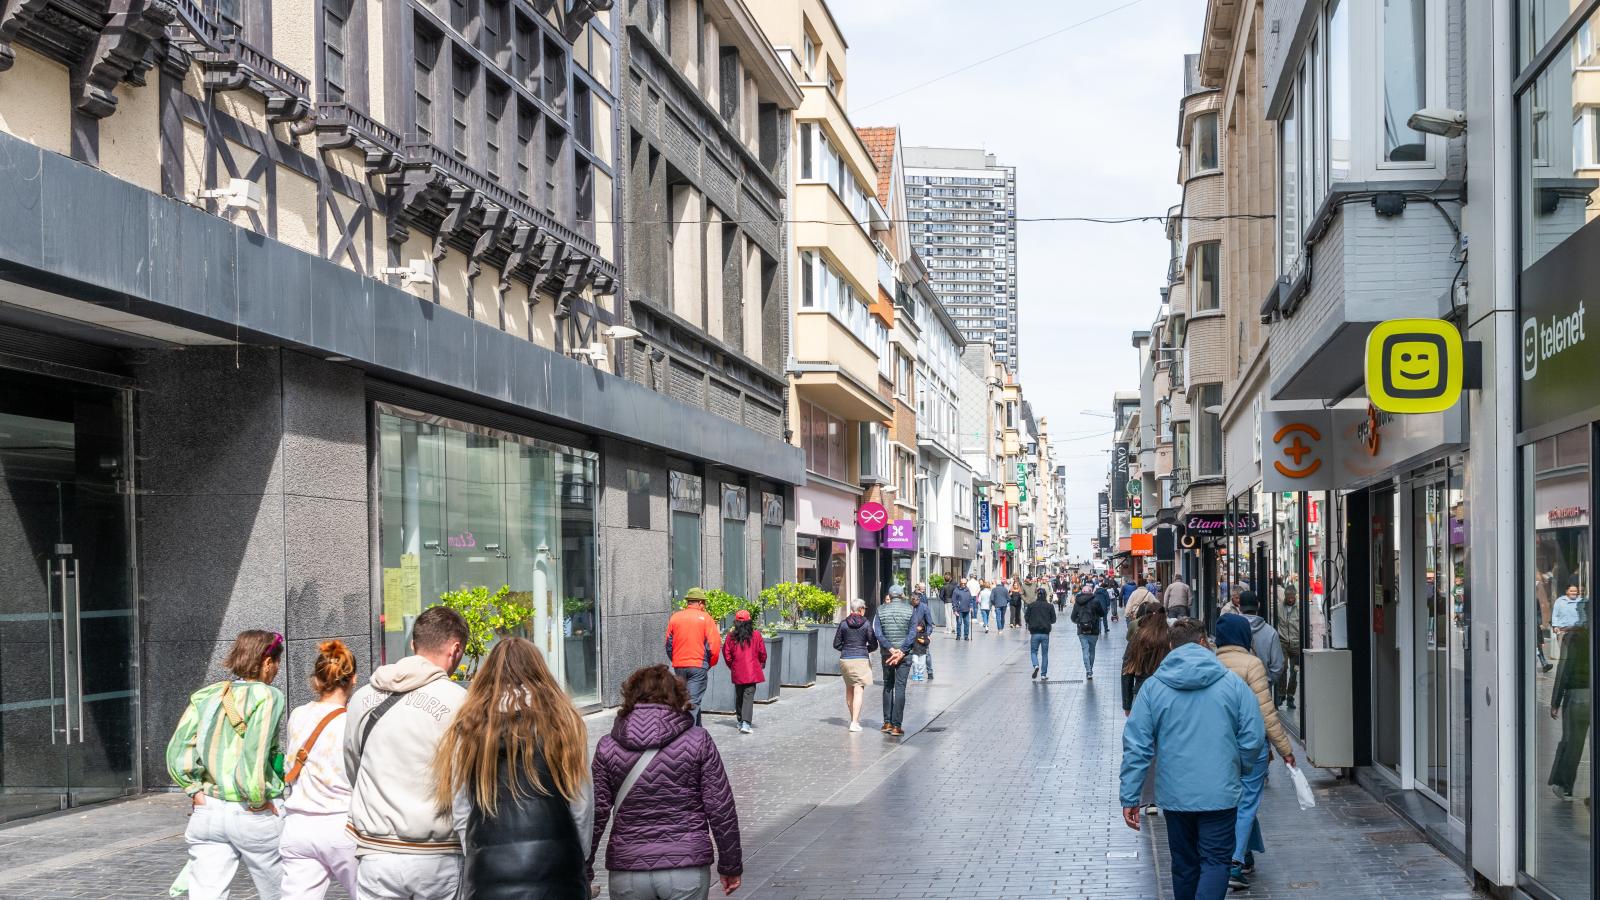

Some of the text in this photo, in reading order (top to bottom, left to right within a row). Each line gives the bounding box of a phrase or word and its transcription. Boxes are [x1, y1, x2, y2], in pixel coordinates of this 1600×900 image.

[1540, 299, 1586, 360] telenet
[1117, 447, 1127, 473] INNO
[1017, 467, 1025, 497] JULES
[1100, 519, 1108, 538] DENIM
[404, 690, 451, 722] YORK
